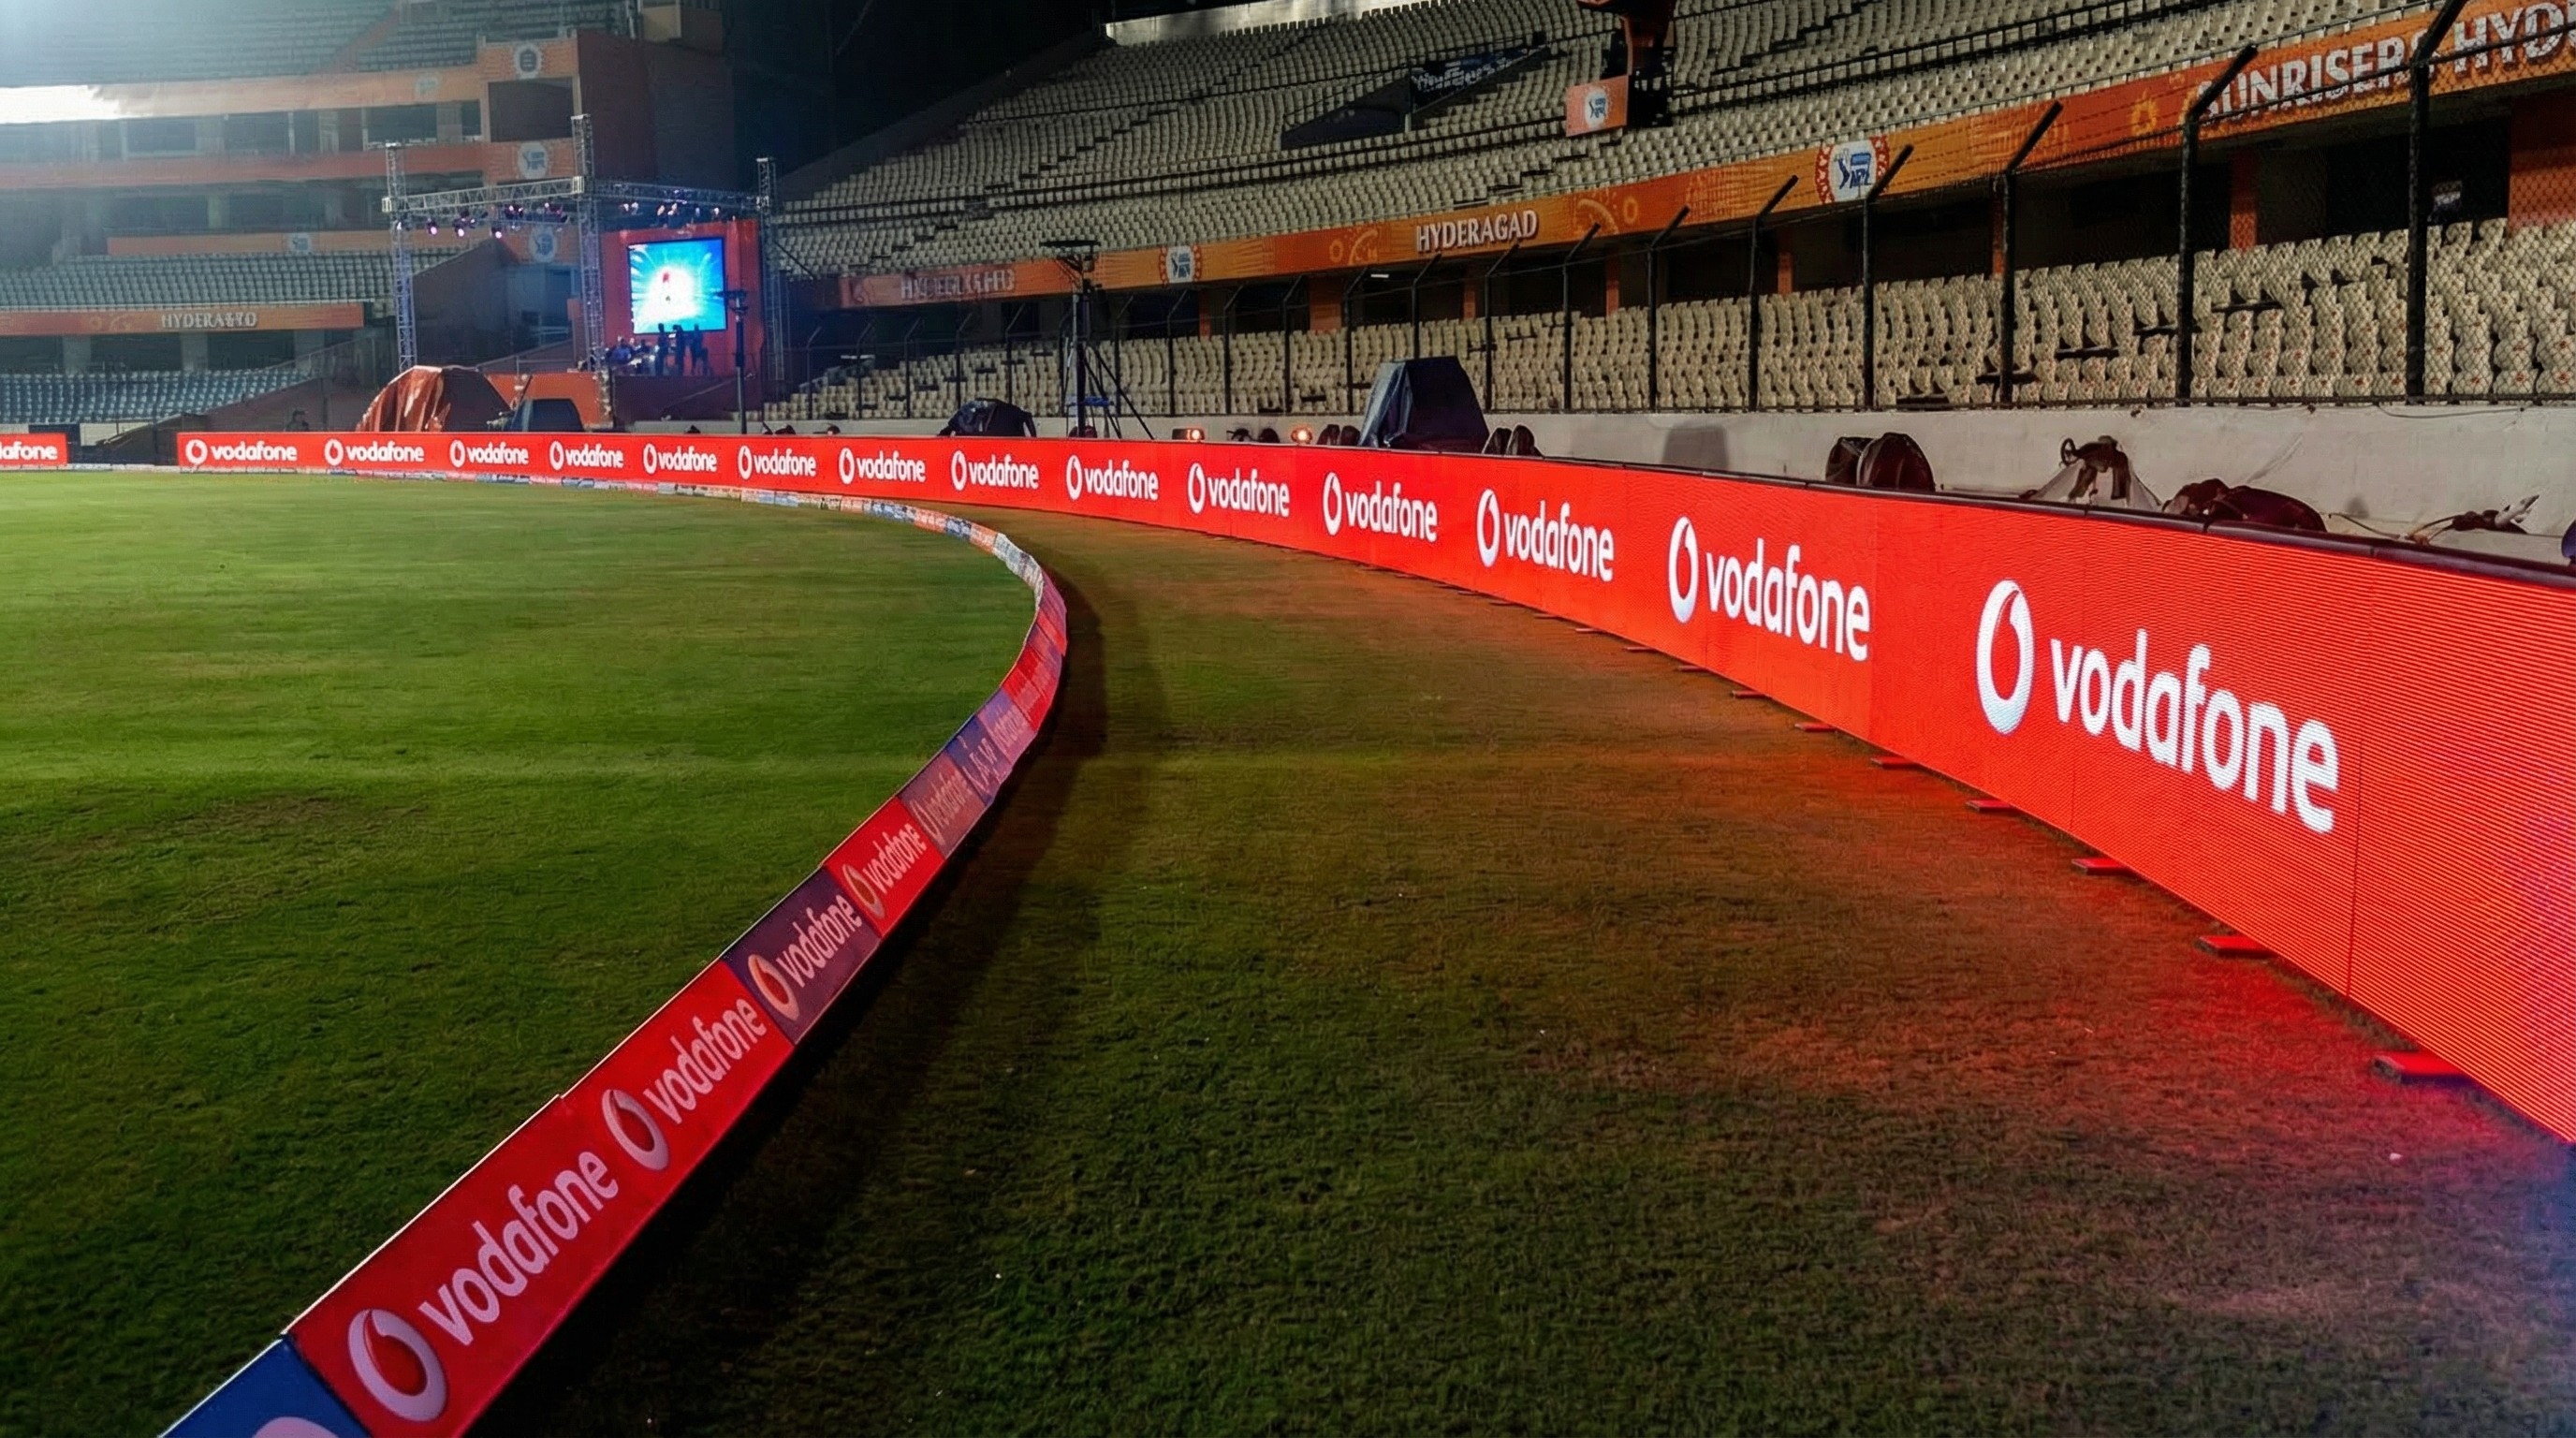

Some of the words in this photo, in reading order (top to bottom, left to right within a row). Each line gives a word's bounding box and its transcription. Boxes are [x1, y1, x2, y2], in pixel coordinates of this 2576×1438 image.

[2196, 28, 2440, 125] UNRISER
[0, 440, 58, 461] afone
[210, 440, 298, 462] vodafone
[344, 440, 425, 462] vodafone
[467, 441, 529, 465] vodafone
[564, 443, 624, 468] vodafone
[657, 446, 718, 473] vodafone
[753, 448, 817, 477] vodafone
[856, 450, 926, 483] vodafone
[968, 454, 1039, 490] vodafone
[1084, 459, 1159, 501] vodafone
[1207, 468, 1290, 518] vodafone
[1345, 480, 1438, 543] vodafone
[1503, 500, 1615, 582] vodafone
[1705, 537, 1870, 662] vodafone
[2050, 628, 2340, 834] vodafone
[862, 821, 928, 895] vodafone
[776, 892, 863, 989] vodafone
[643, 998, 767, 1124] vodafone
[418, 1151, 619, 1346] vodafone
